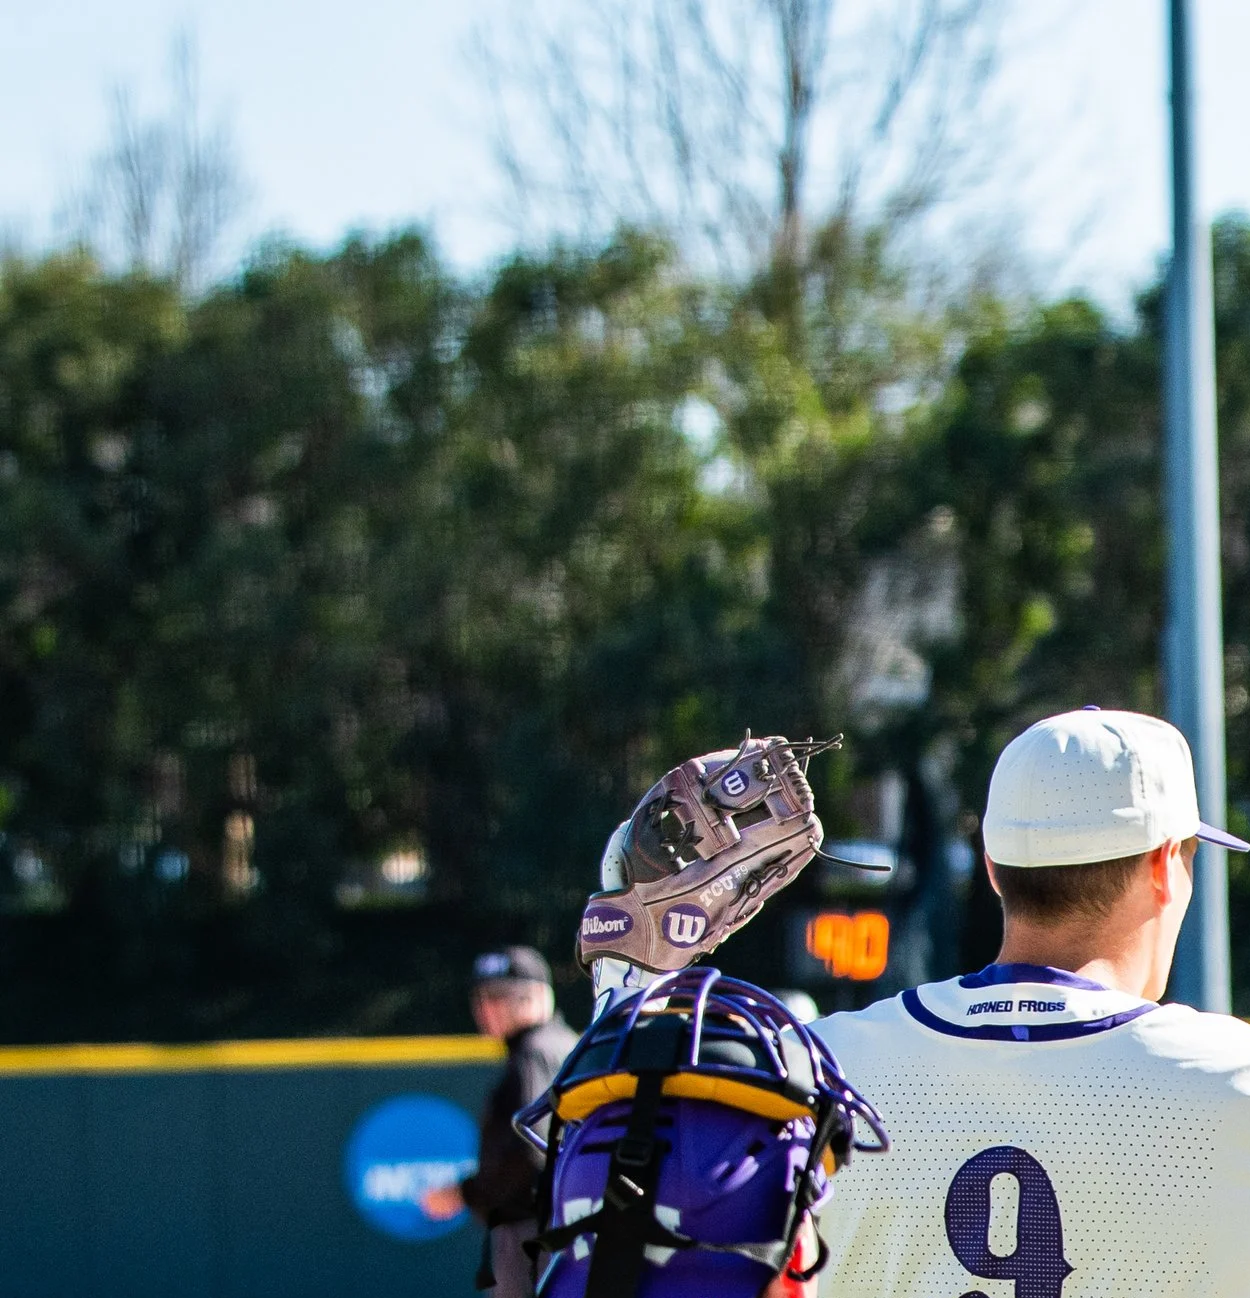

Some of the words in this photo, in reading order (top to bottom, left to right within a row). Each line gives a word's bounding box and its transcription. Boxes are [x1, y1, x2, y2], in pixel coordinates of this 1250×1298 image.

[700, 875, 734, 907] TCU
[733, 864, 749, 879] #9
[668, 911, 707, 944] W
[966, 1000, 1014, 1016] HORNED
[1018, 1000, 1066, 1012] FROGS
